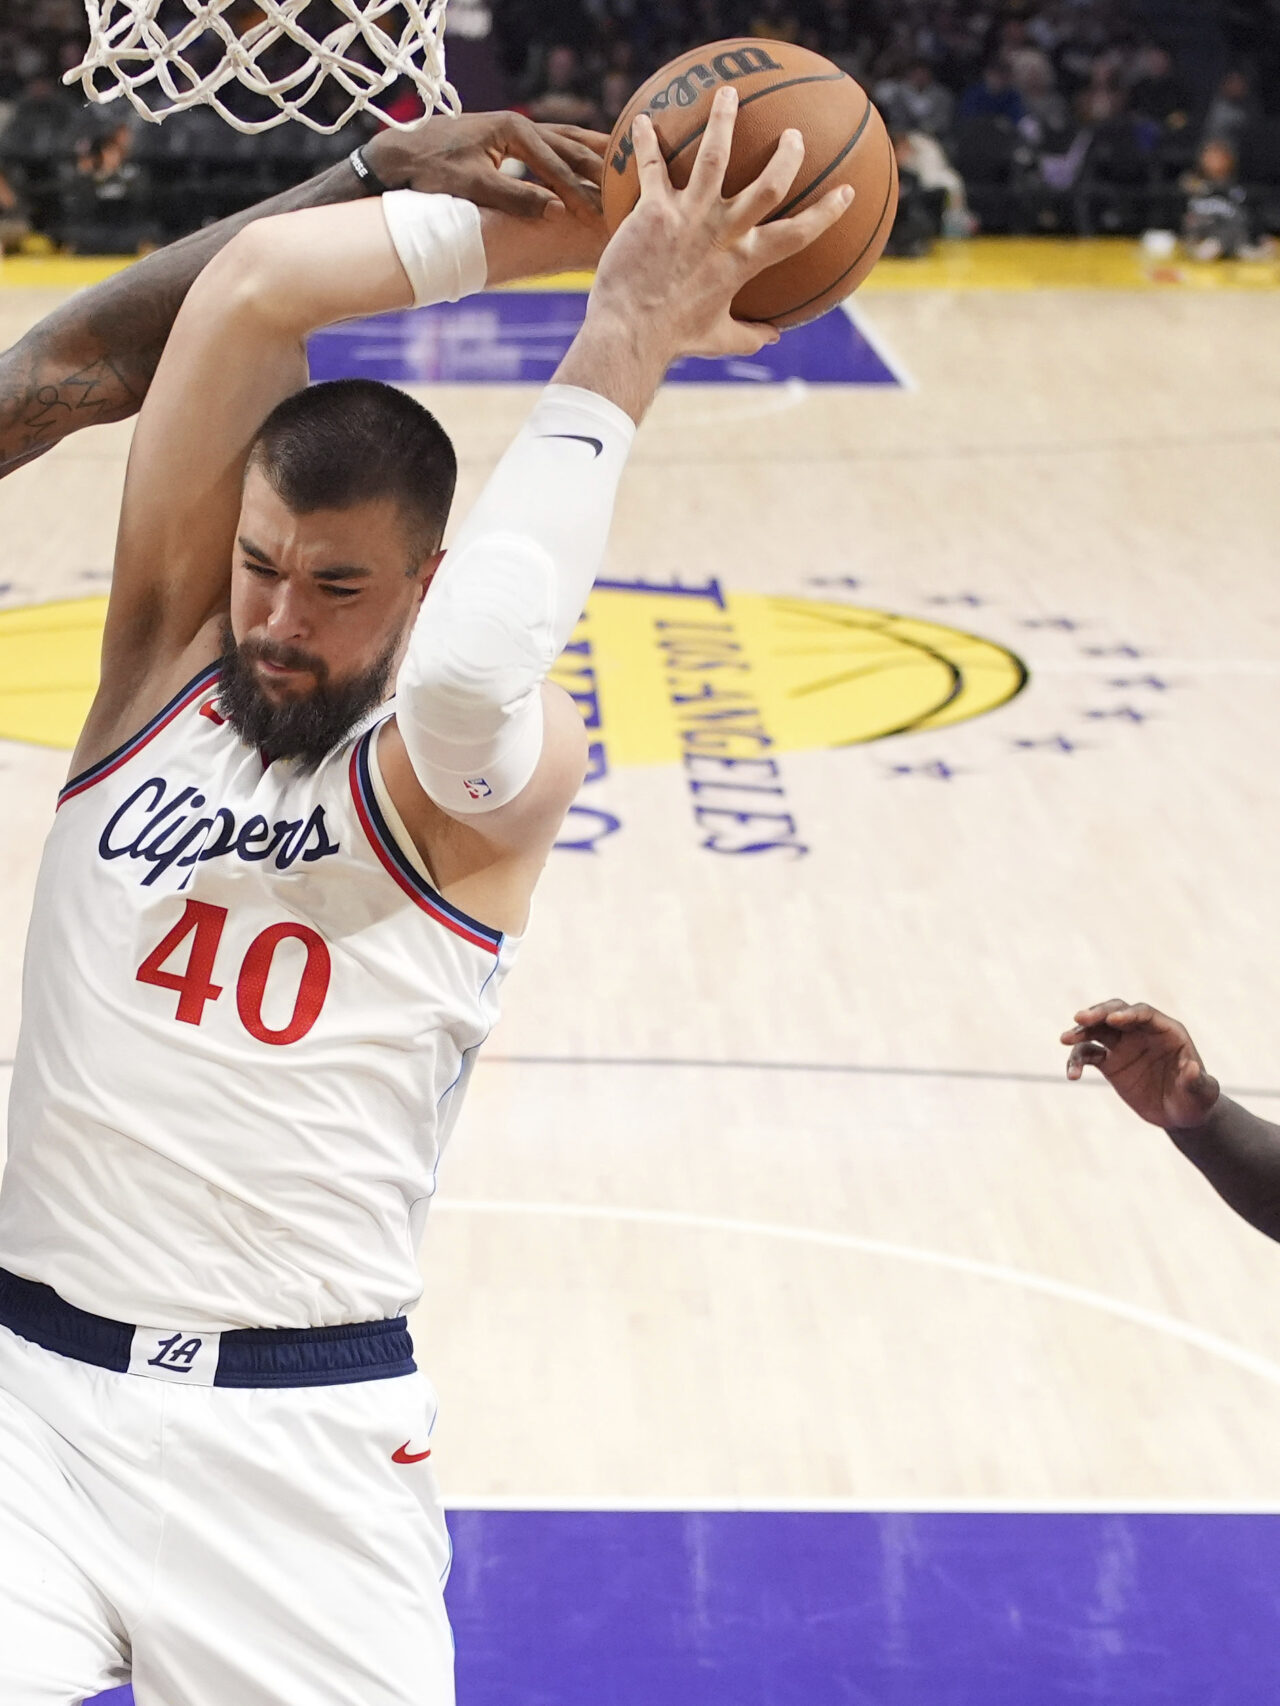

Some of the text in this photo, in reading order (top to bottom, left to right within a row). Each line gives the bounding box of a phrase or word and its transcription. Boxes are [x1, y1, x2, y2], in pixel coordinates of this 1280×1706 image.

[611, 47, 783, 176] Wilsn
[97, 776, 340, 891] Clippers
[135, 898, 332, 1046] 40
[147, 1332, 202, 1374] LA
